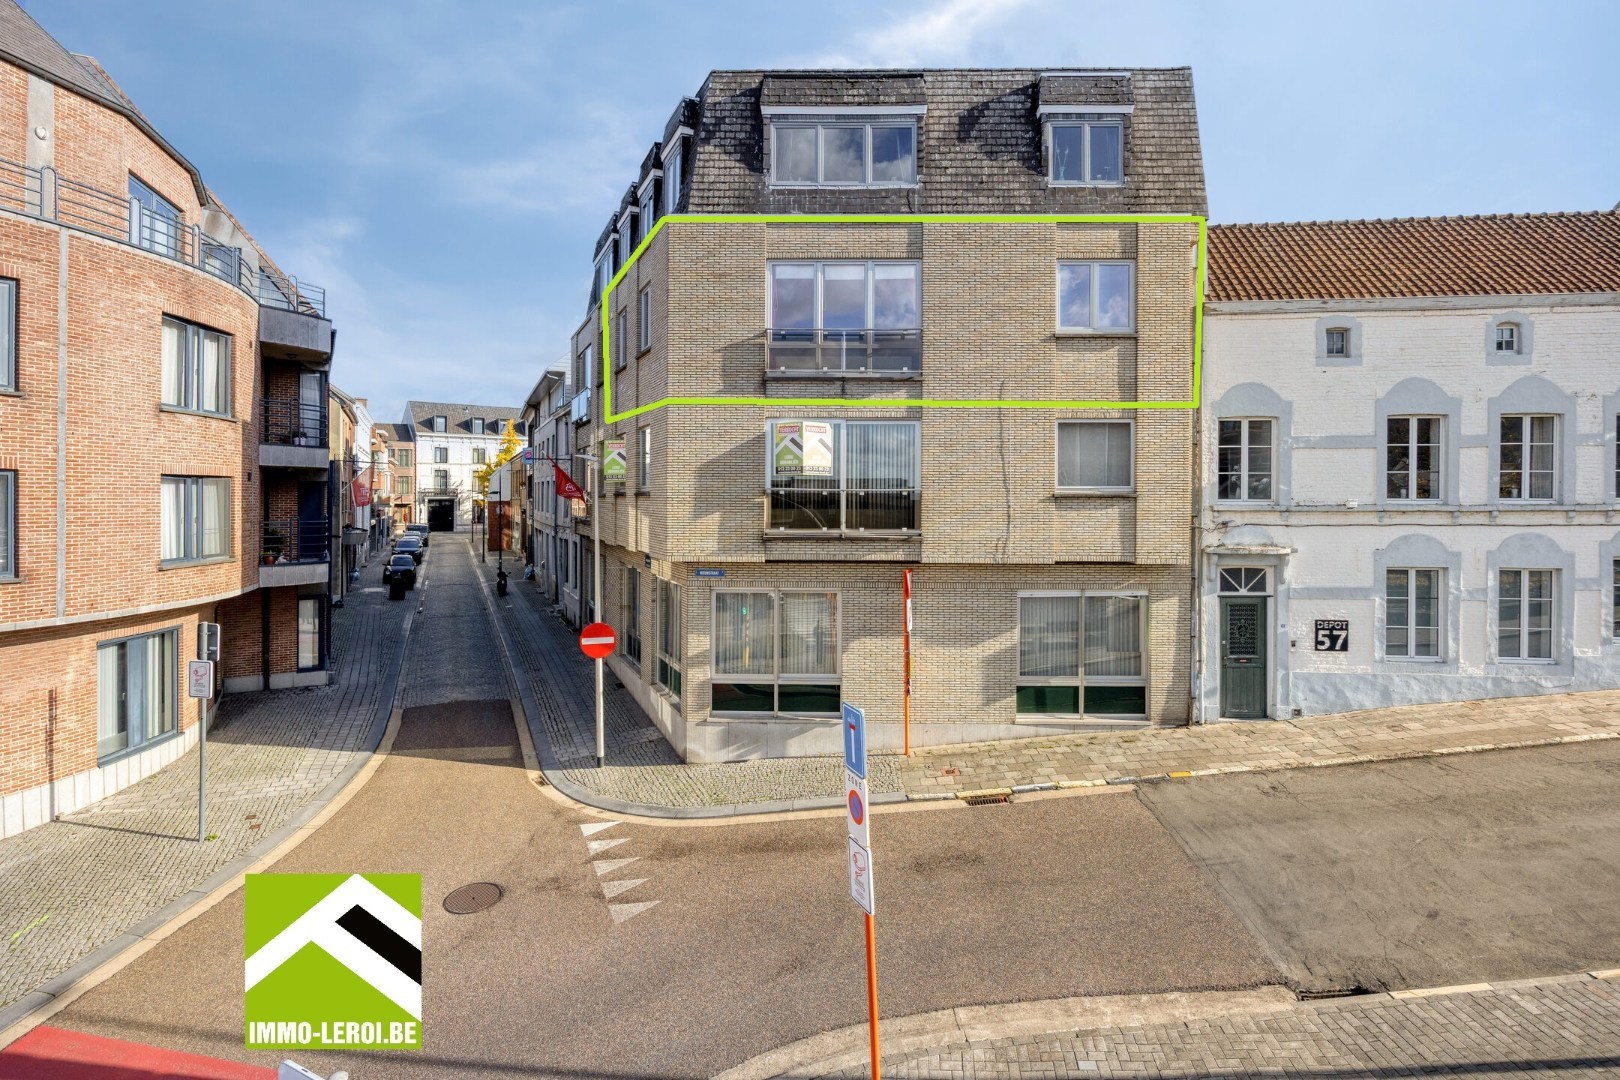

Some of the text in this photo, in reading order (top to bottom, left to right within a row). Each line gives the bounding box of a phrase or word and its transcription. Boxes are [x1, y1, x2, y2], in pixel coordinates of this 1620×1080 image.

[1317, 621, 1348, 629] DEPOT
[1317, 630, 1348, 650] 57
[847, 773, 862, 791] ZONE
